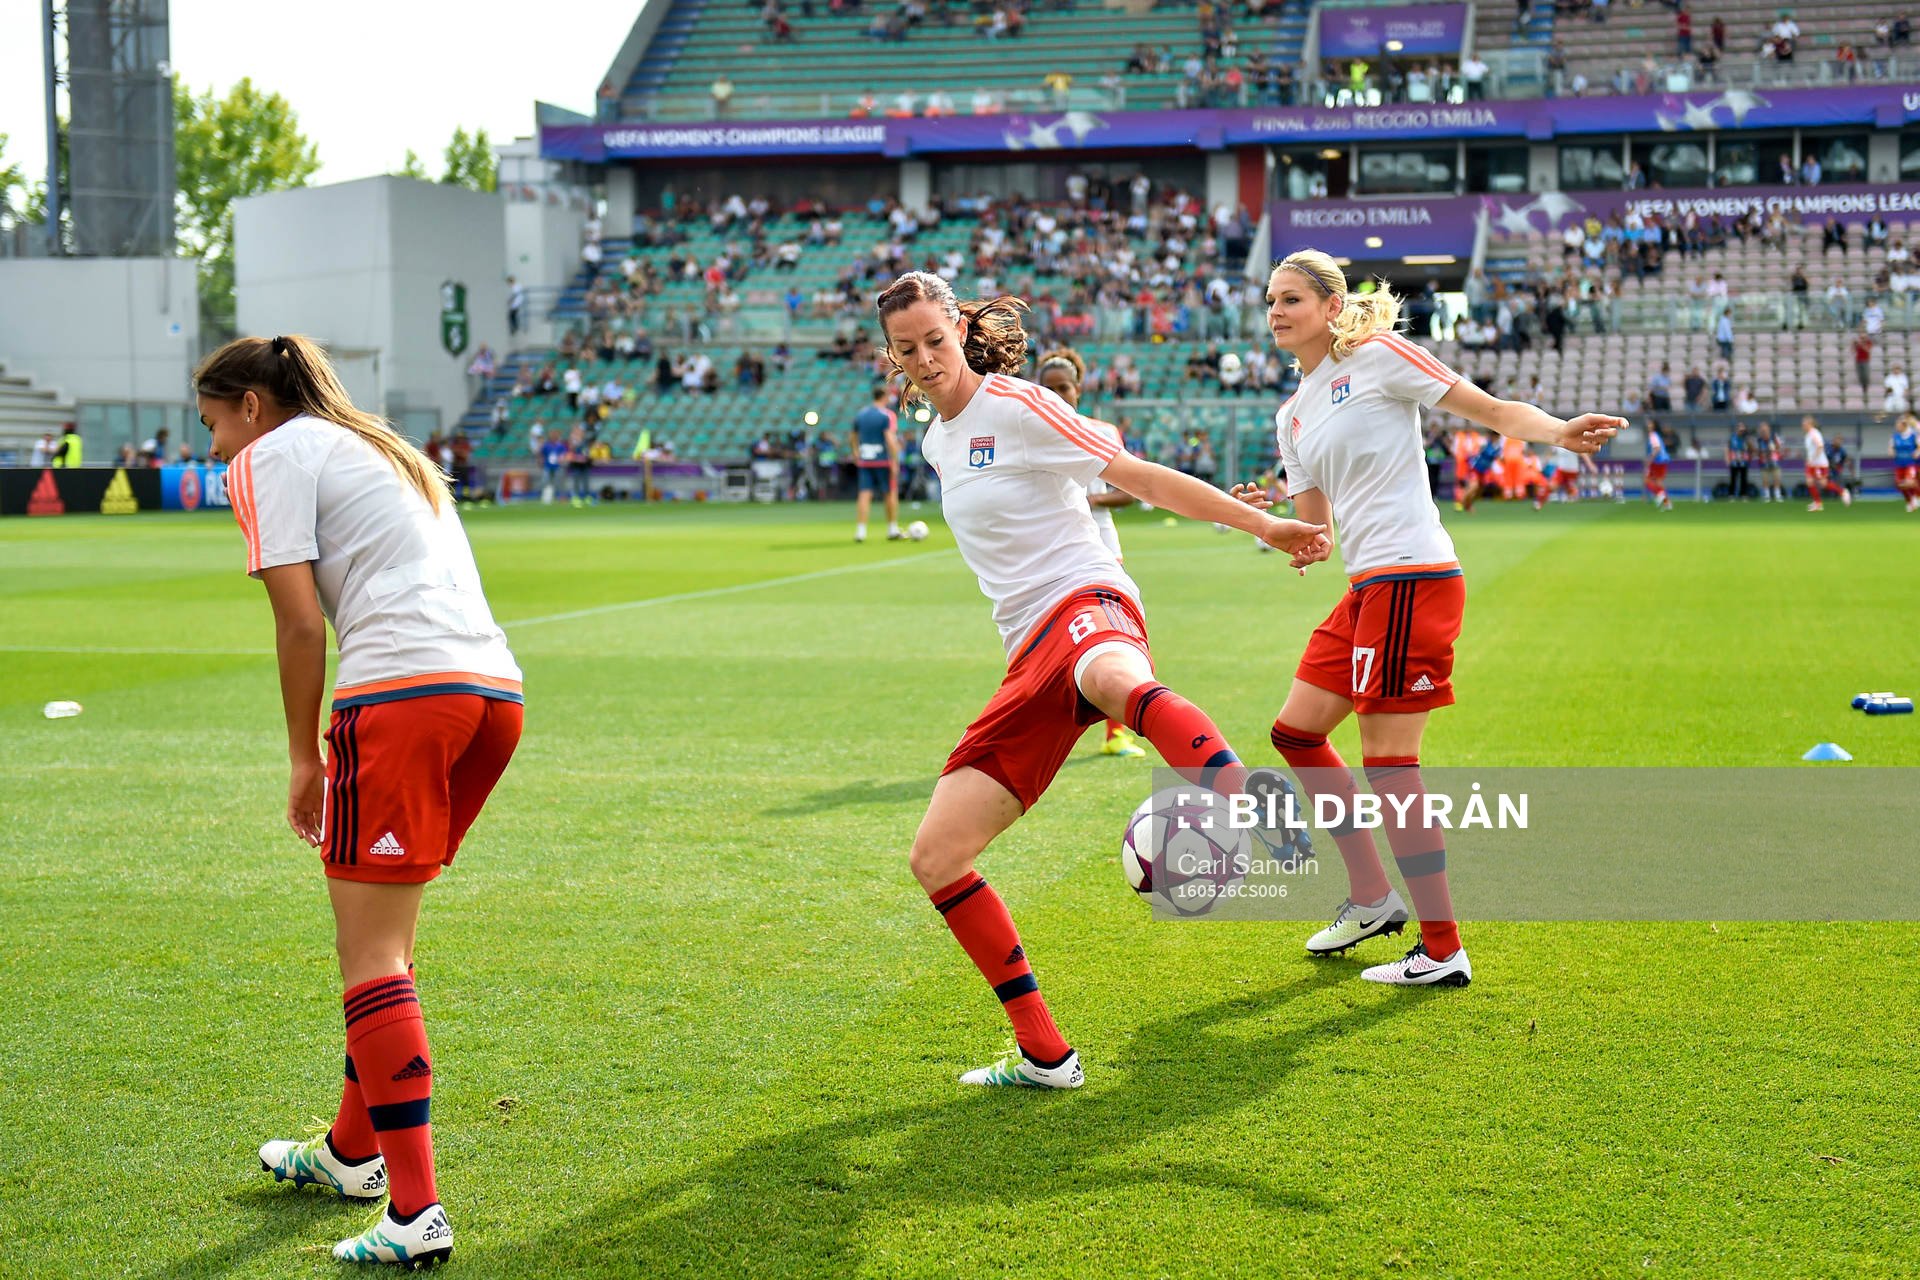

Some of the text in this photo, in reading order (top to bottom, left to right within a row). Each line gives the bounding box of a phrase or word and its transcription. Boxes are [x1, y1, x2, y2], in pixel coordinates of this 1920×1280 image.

[1353, 112, 1428, 129] REGGIO
[1431, 109, 1496, 127] EMILIA
[1291, 206, 1432, 227] REGGIO EMILIA
[1678, 198, 1764, 217] WOMEN'S
[971, 449, 992, 465] OL
[1068, 612, 1097, 645] 8
[369, 846, 404, 855] adidas
